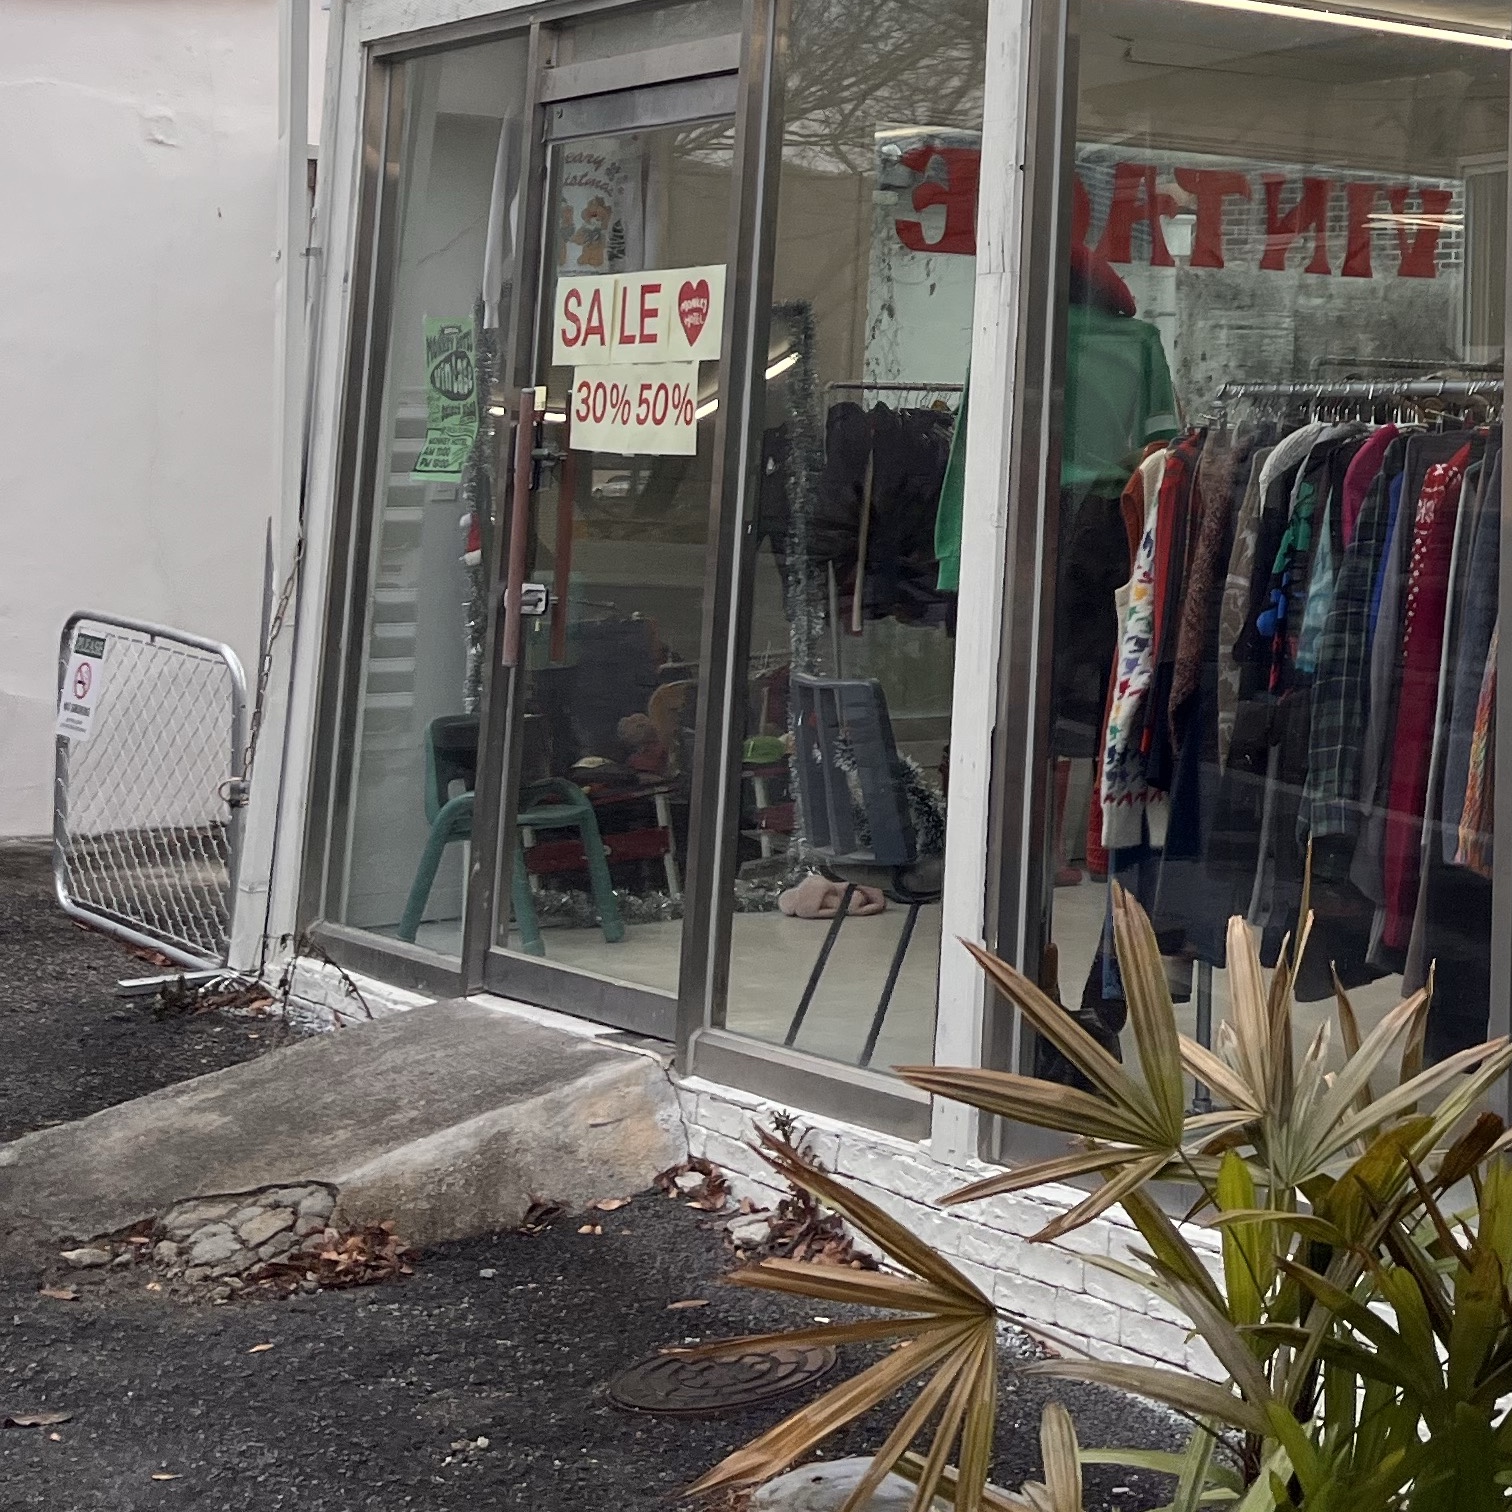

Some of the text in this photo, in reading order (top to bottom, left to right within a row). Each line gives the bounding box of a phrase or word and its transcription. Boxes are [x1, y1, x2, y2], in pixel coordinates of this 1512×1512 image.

[561, 283, 662, 348] SALE
[575, 380, 694, 426] 30% 50%
